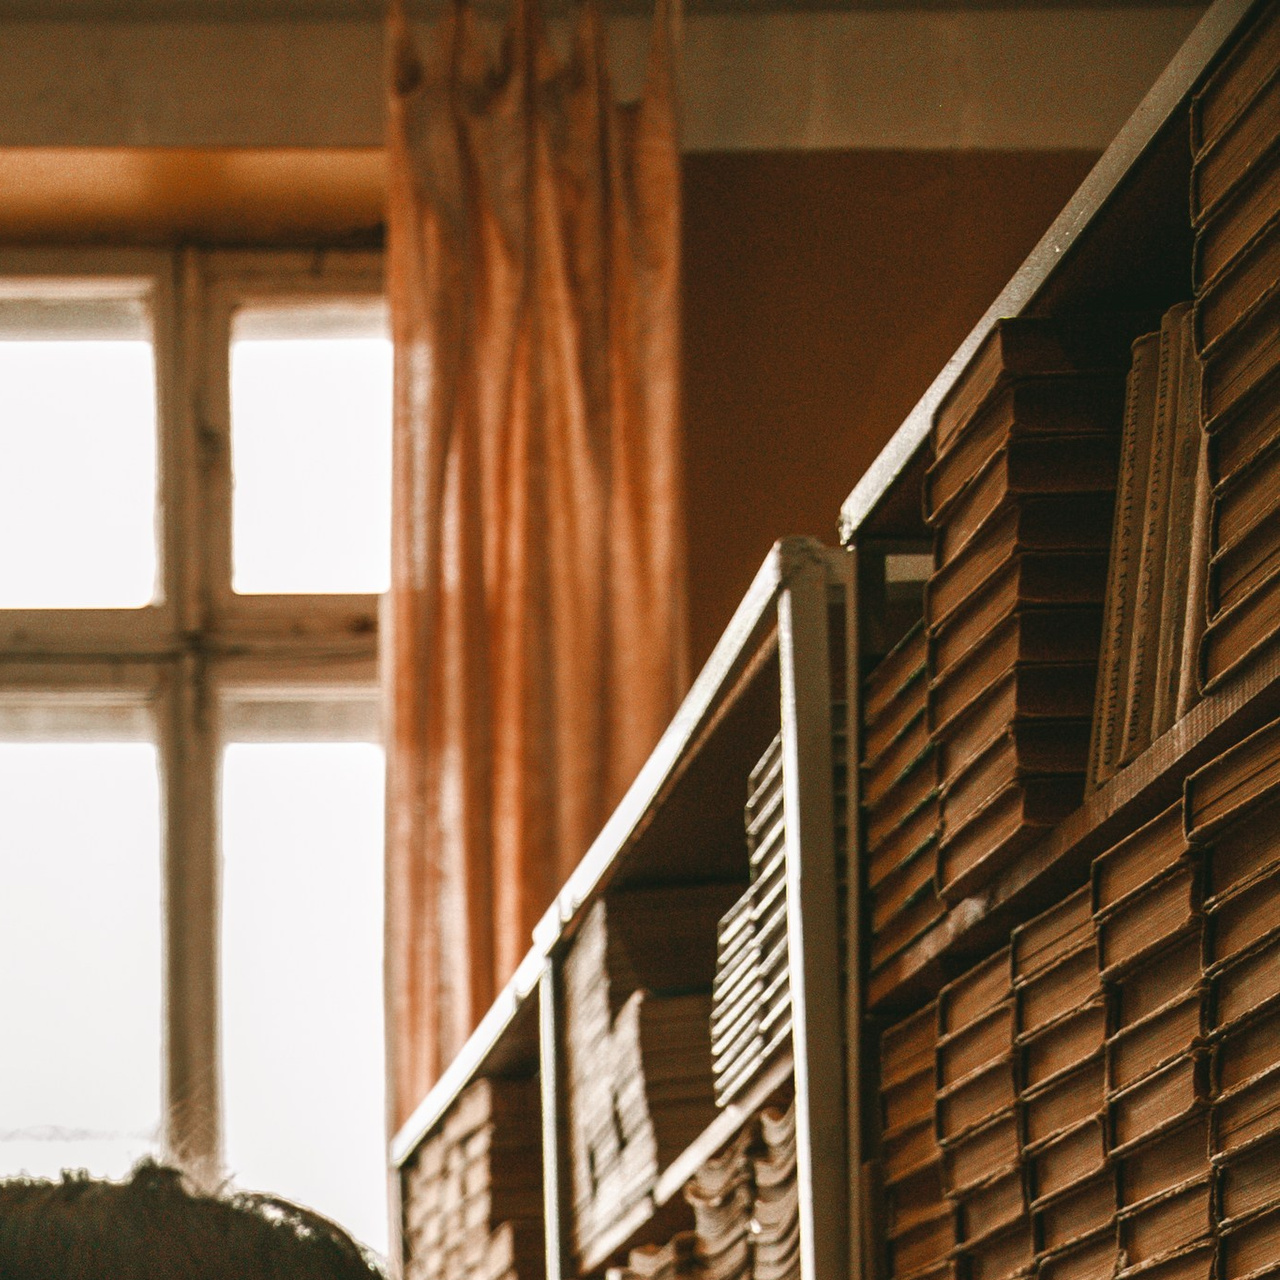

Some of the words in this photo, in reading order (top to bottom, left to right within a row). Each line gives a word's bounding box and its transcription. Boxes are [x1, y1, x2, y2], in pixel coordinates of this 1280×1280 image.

[1104, 657, 1119, 766] СБОРНИК
[1113, 573, 1127, 650] ЗАДАЧ
[1130, 634, 1144, 741] СБОРНИК
